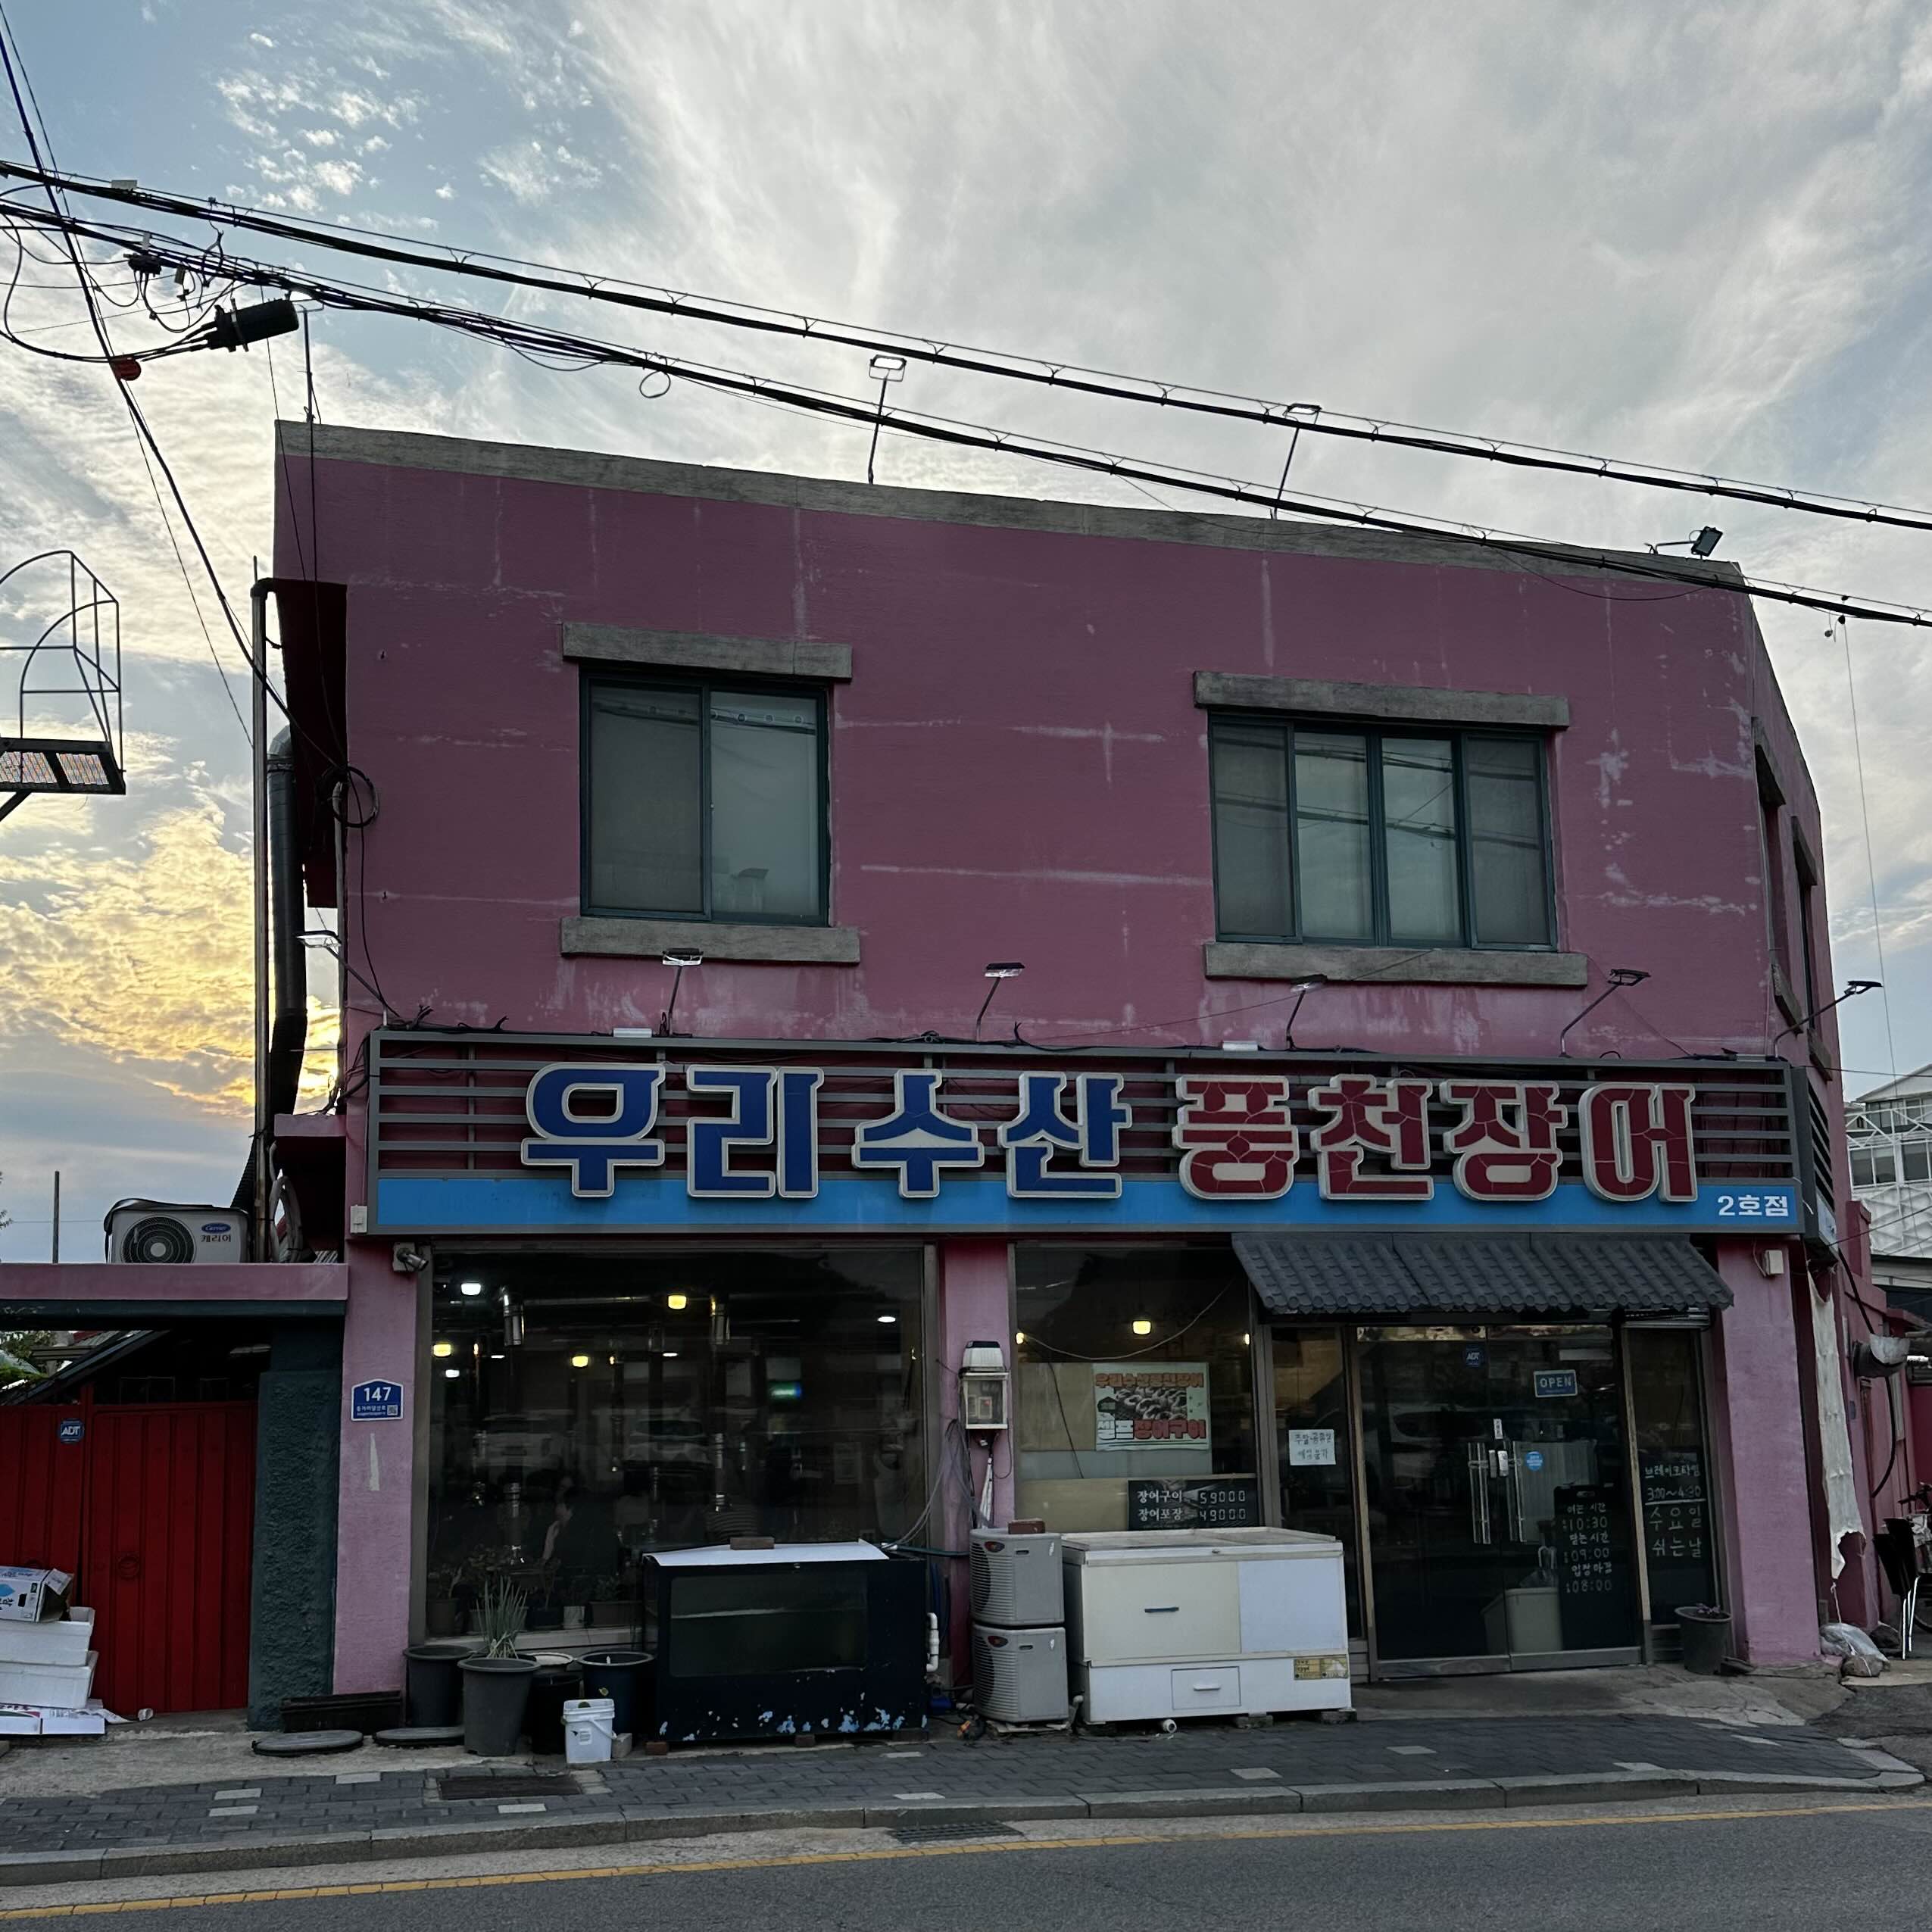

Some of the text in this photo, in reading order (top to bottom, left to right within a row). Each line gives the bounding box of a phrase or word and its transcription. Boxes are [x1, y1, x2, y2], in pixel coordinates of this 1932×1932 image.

[521, 1062, 1696, 1202] 우리수산 풍천장어
[1718, 1194, 1788, 1216] 2호점
[1540, 1376, 1572, 1388] OPEN
[364, 1387, 392, 1402] 147
[61, 1425, 81, 1437] ADT
[1138, 1490, 1246, 1504] 장어구이 59000
[1138, 1507, 1247, 1522] 장어포장 49000
[1650, 1504, 1702, 1531] 수요일
